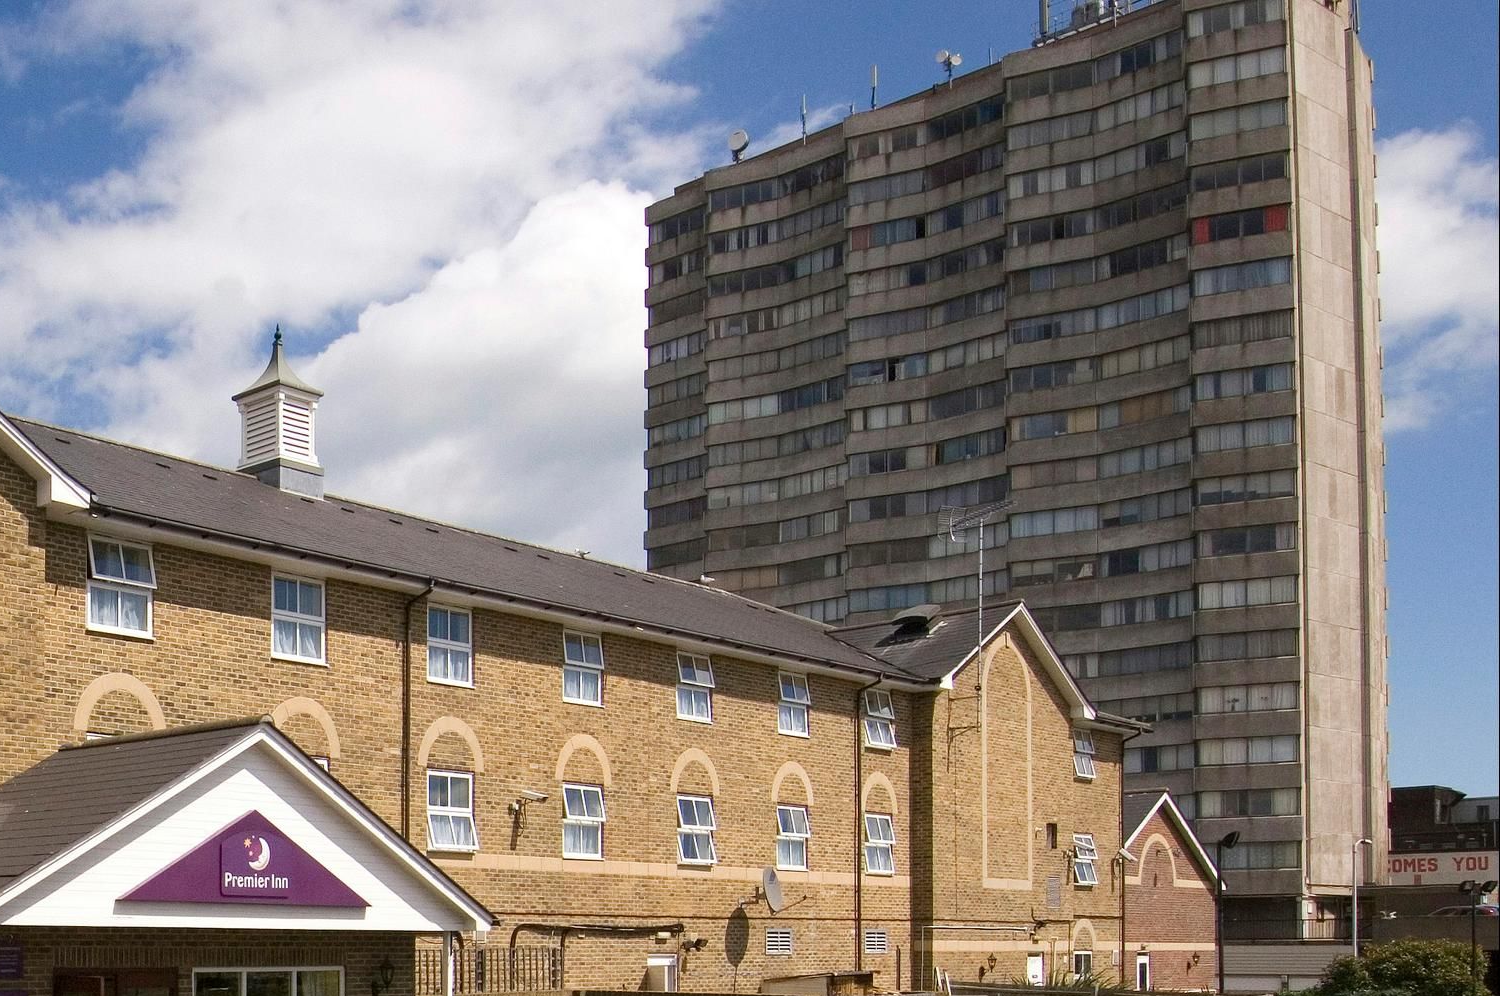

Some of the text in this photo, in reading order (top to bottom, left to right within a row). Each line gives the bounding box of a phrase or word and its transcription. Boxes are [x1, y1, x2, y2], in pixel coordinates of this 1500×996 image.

[1388, 856, 1489, 873] OMES YOU
[224, 871, 289, 889] Premier Inn
